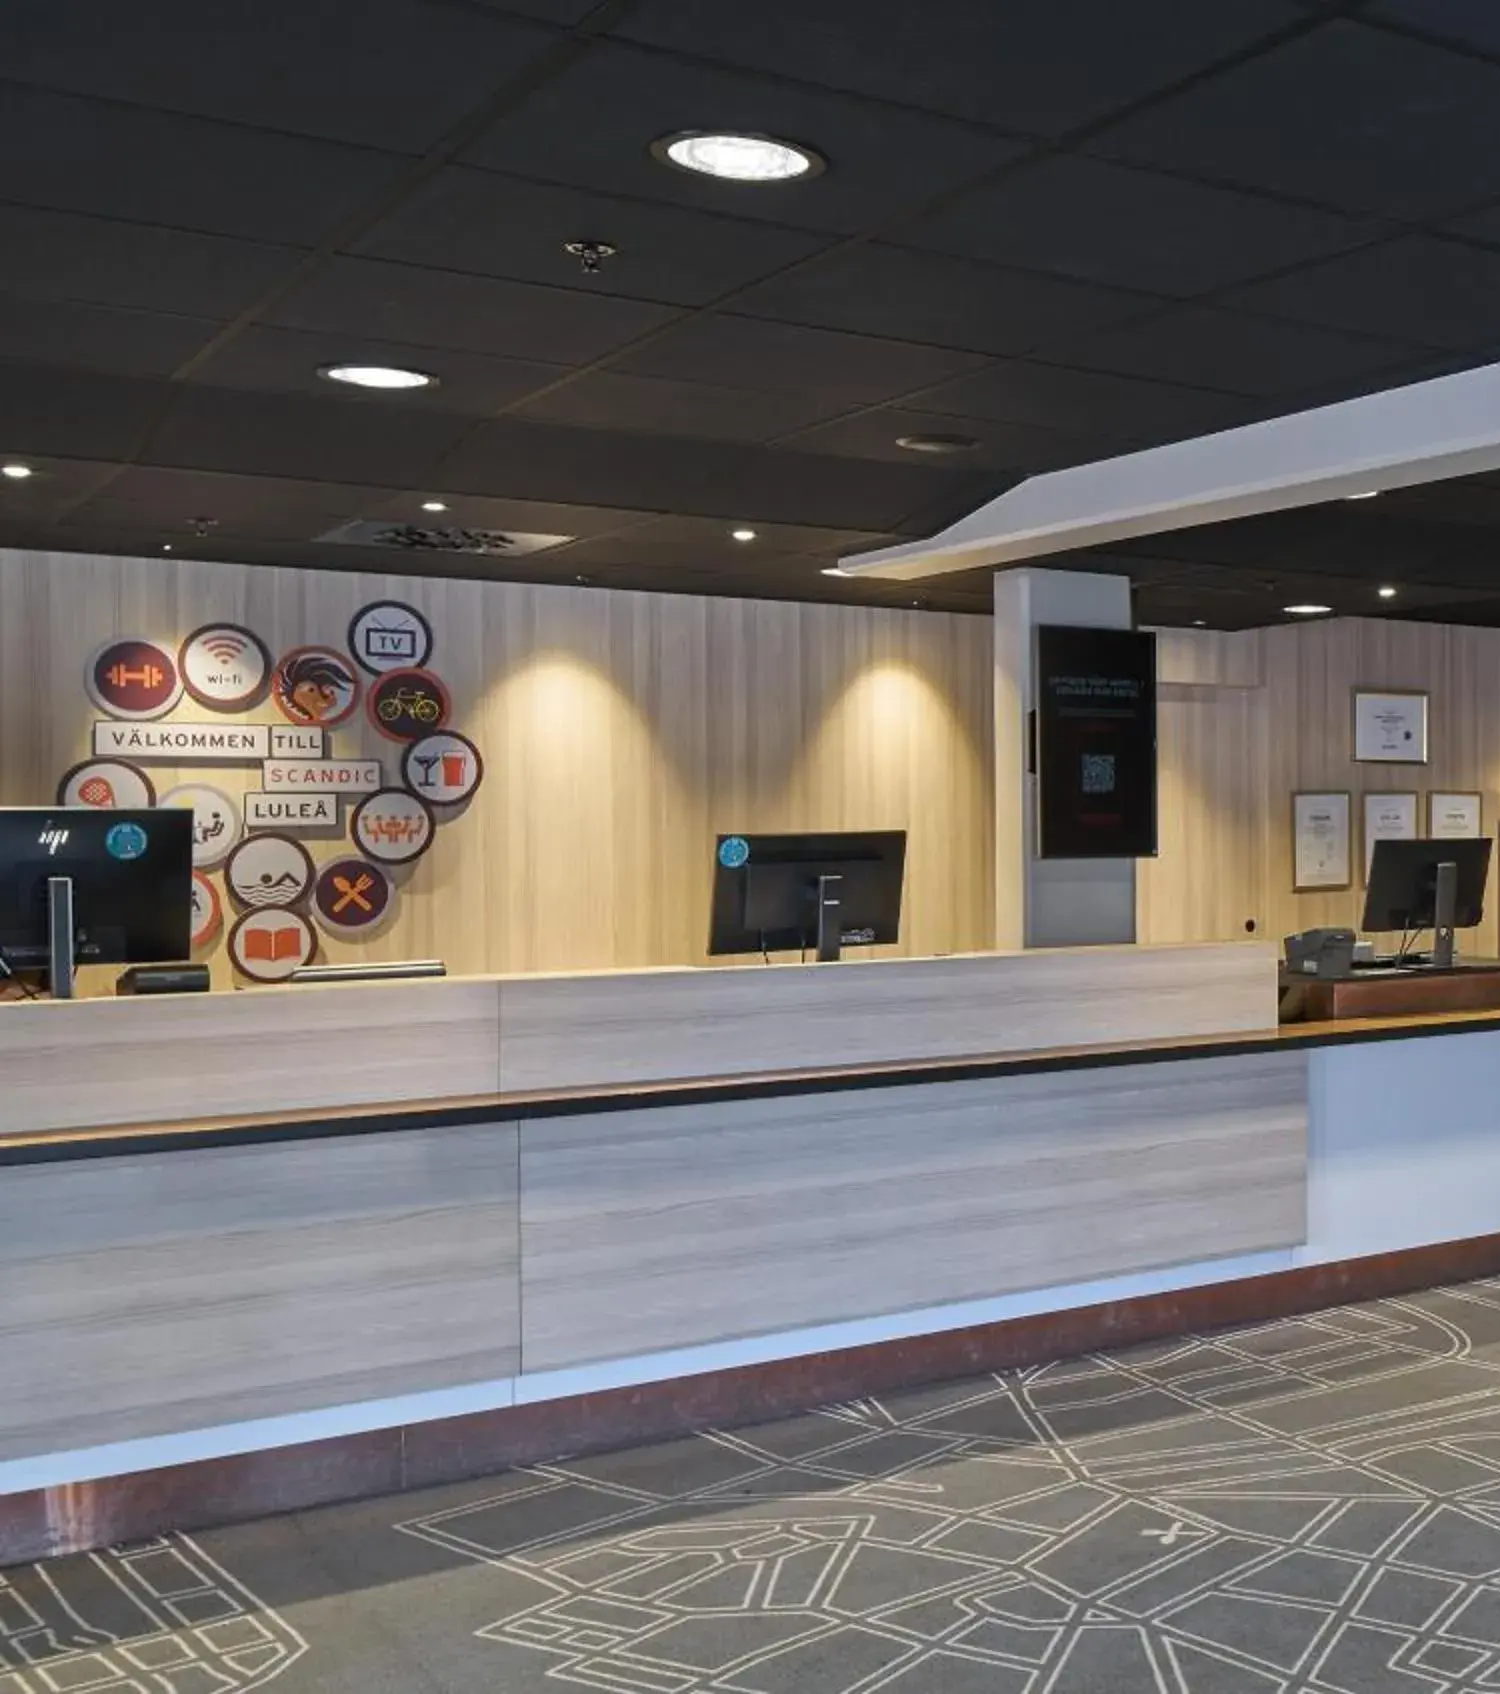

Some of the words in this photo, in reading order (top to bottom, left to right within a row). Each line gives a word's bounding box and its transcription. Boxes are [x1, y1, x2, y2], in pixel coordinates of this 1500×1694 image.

[378, 636, 404, 651] TV
[207, 671, 242, 685] wi-fi
[112, 729, 256, 749] VÄLKOMMEN
[274, 735, 321, 749] TILL
[270, 769, 377, 784] SCANDIC
[254, 800, 328, 819] LULEÅ
